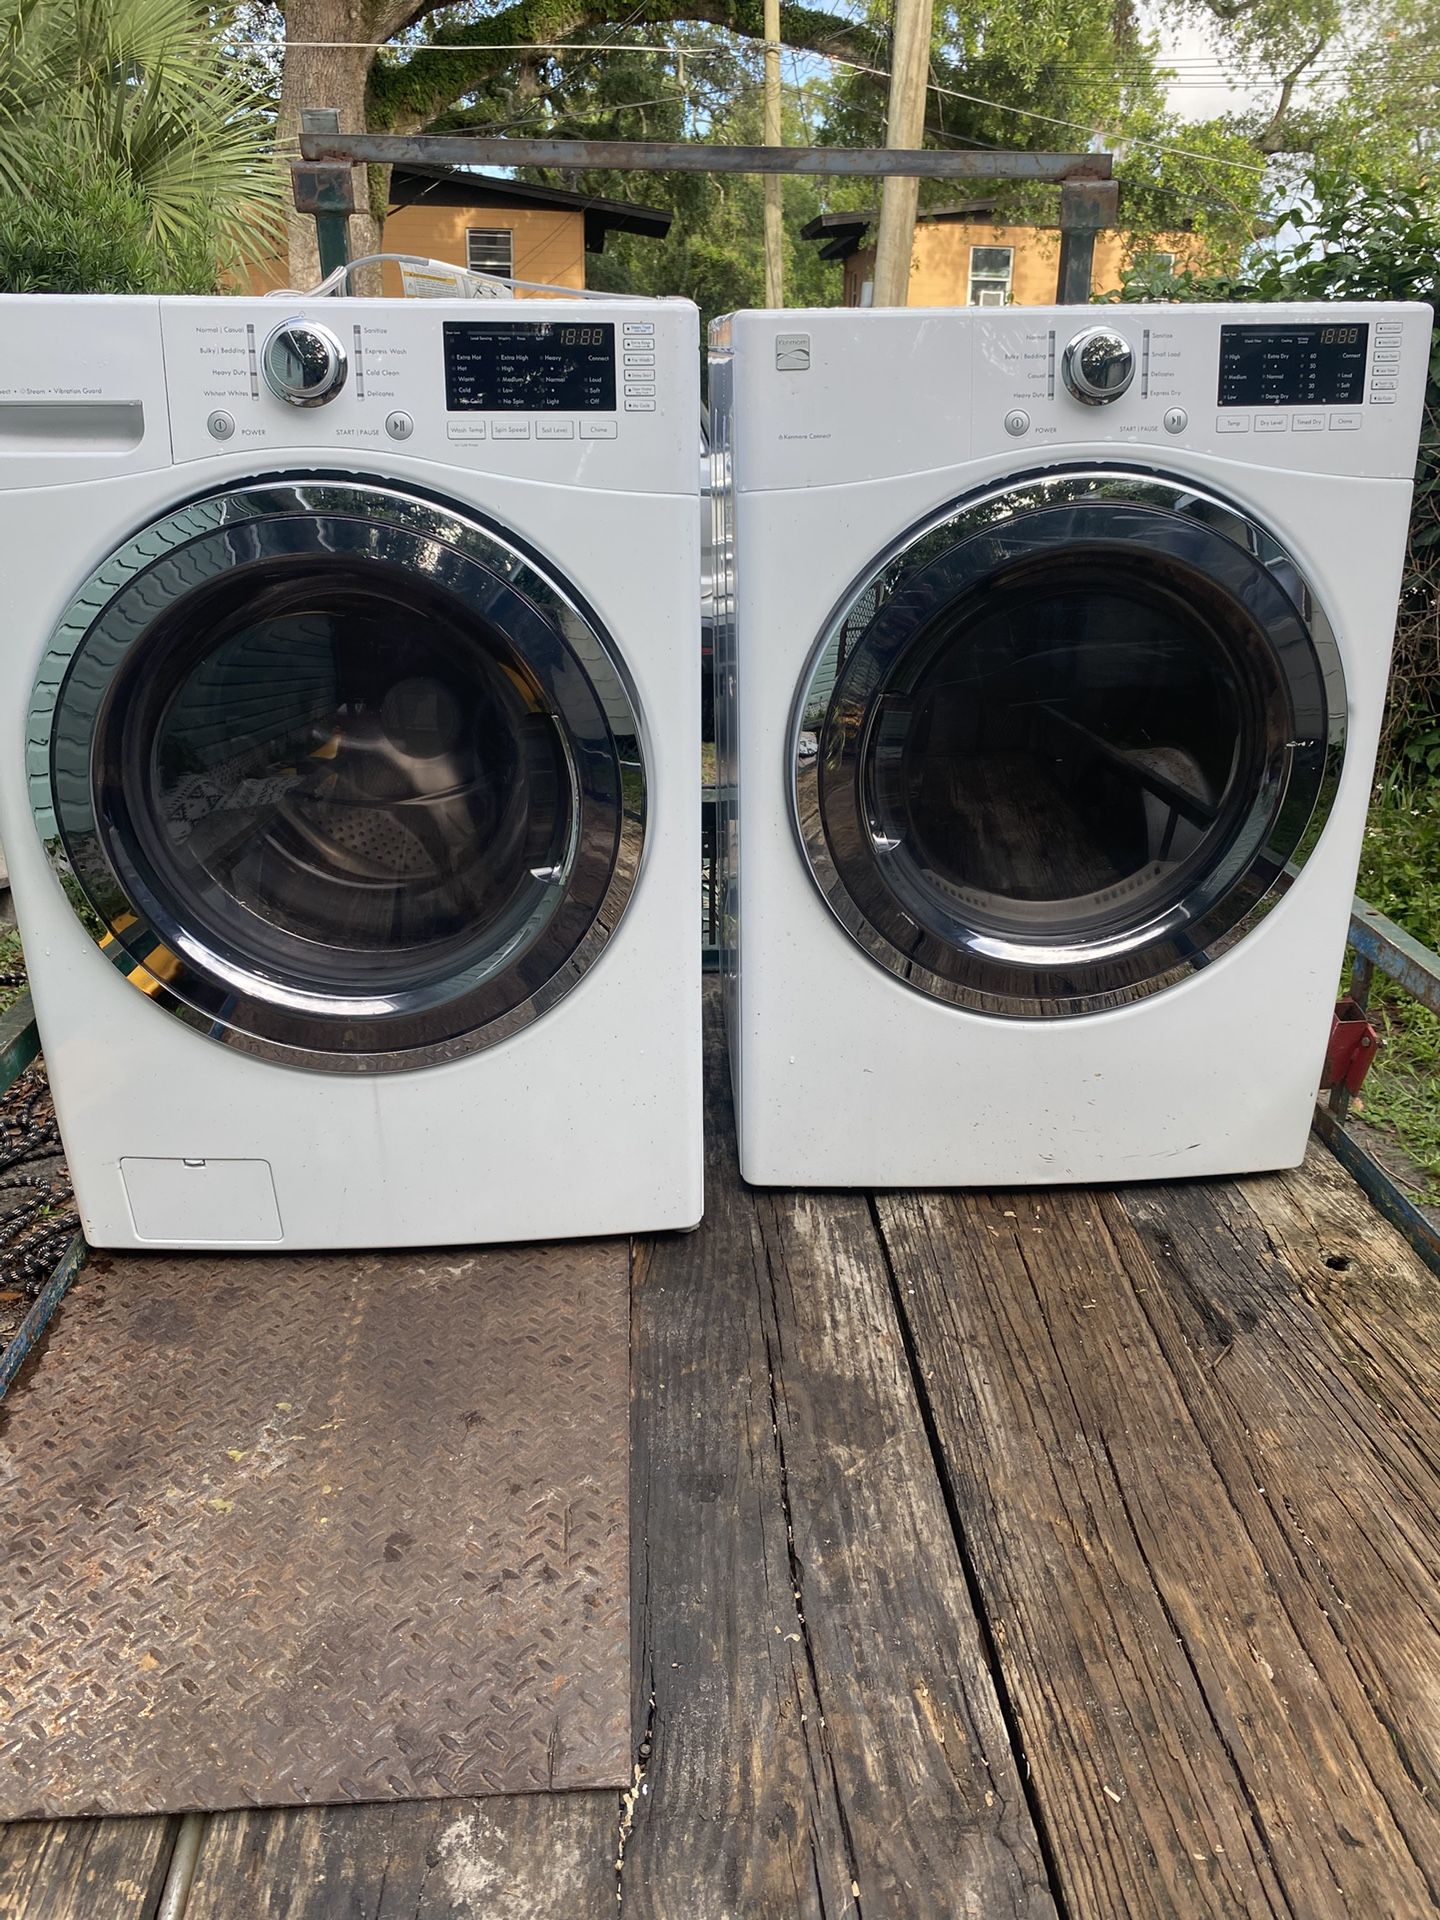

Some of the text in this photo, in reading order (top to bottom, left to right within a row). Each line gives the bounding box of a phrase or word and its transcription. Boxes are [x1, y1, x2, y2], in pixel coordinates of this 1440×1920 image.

[200, 347, 246, 355] Bulky Bedding
[516, 354, 529, 362] High
